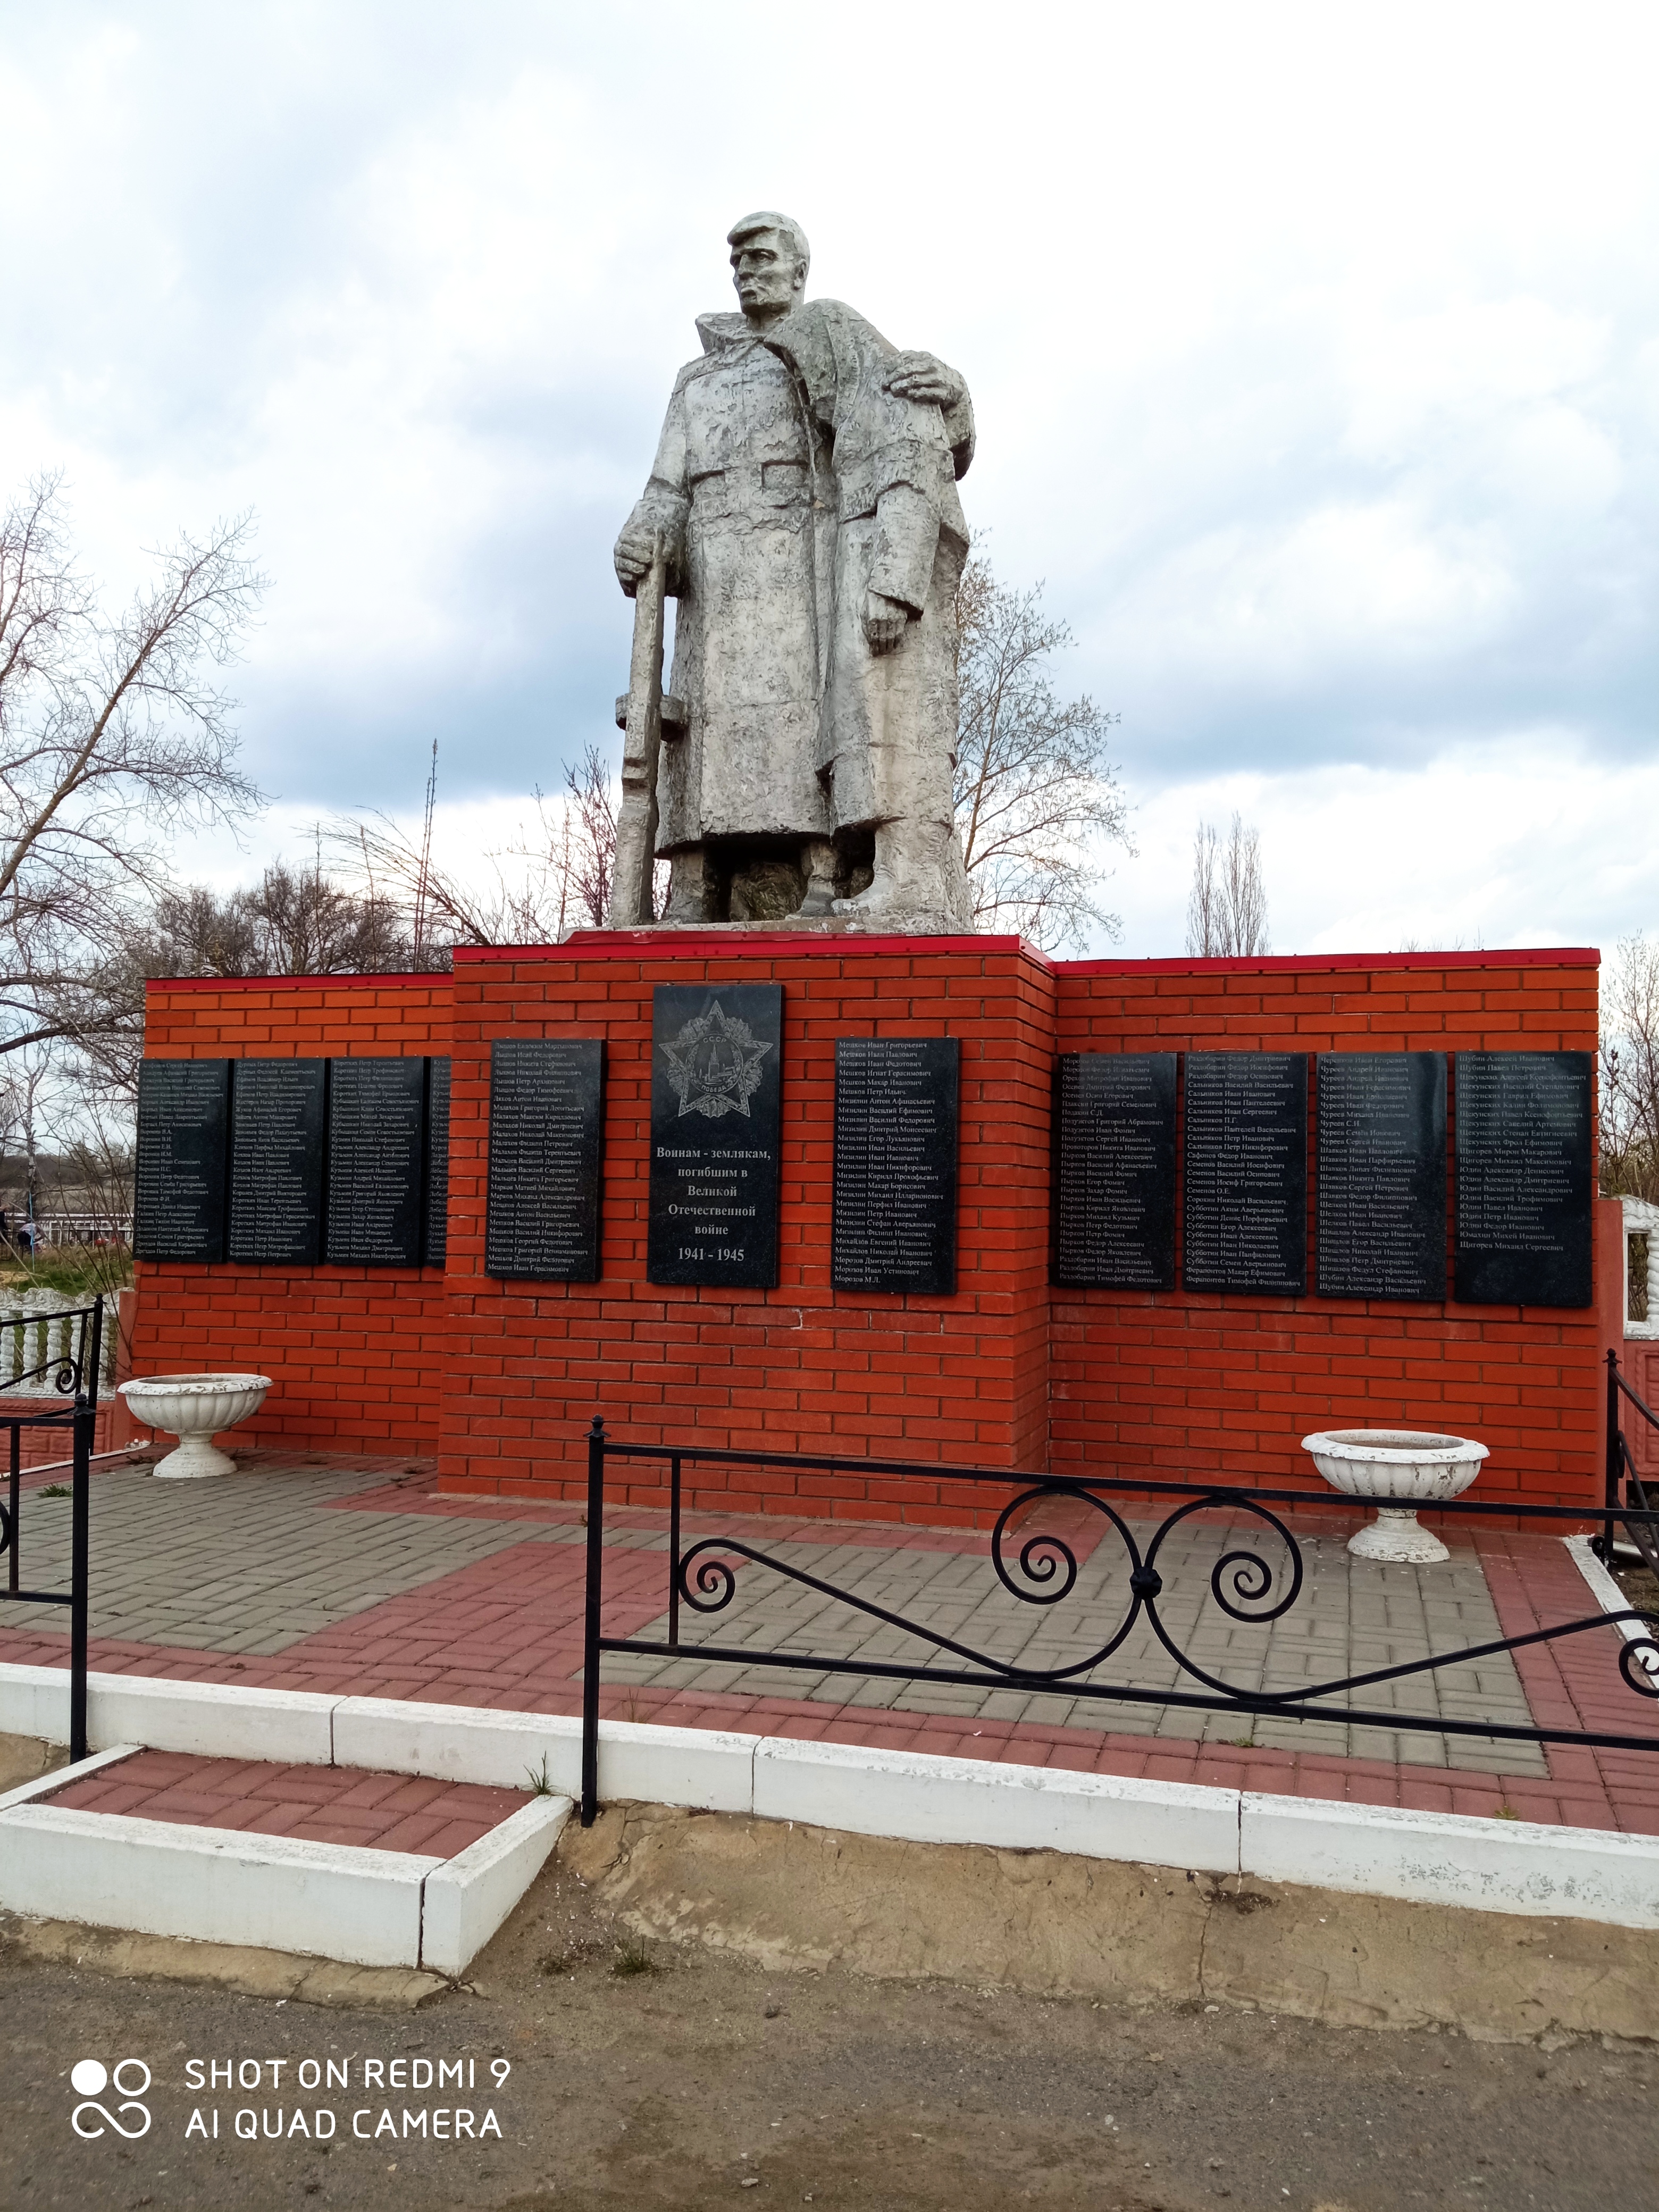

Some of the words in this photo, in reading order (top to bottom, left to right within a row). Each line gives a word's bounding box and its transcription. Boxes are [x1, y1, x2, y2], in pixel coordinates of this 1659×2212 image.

[657, 1147, 700, 1158] Воинам
[711, 1151, 770, 1160] землякам,
[678, 1167, 737, 1177] погибшим
[688, 1186, 737, 1196] Великой
[669, 1204, 756, 1216] Отечественной
[695, 1225, 728, 1235] войне
[678, 1248, 703, 1260] 1941
[717, 1249, 744, 1261] 1945
